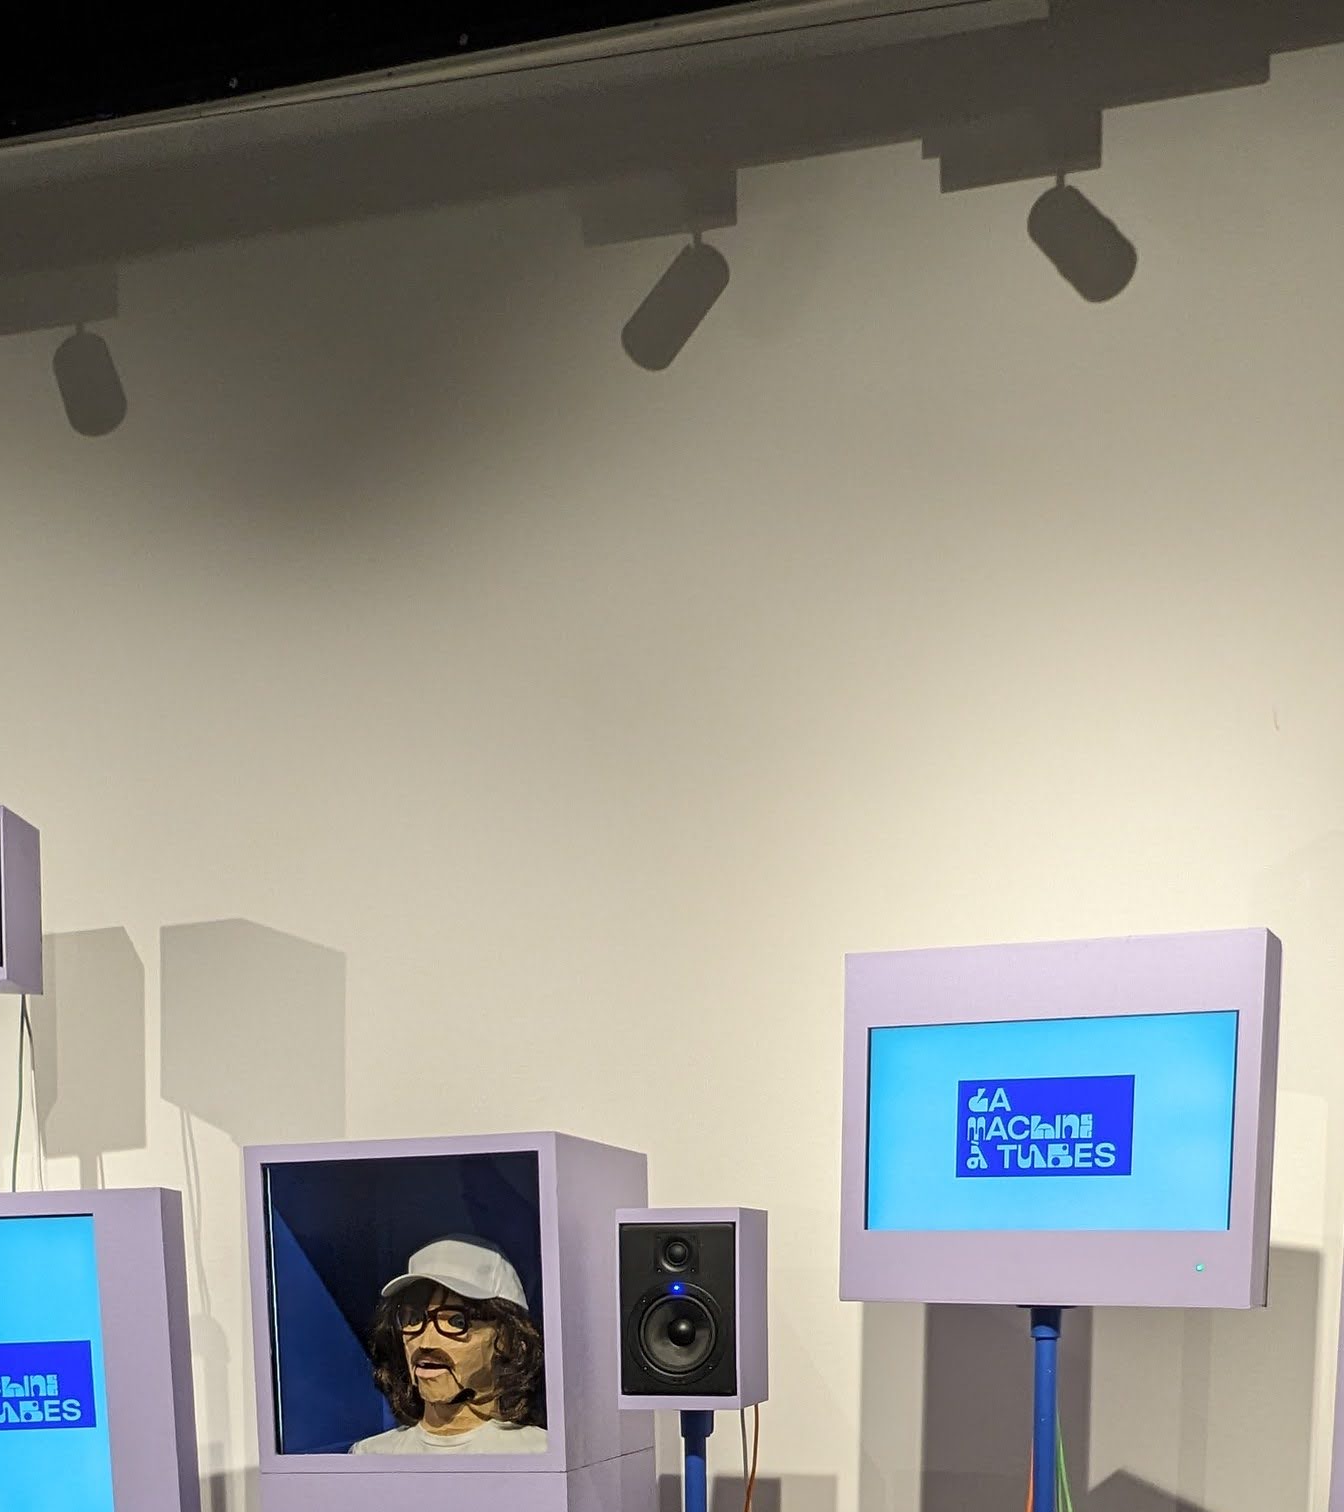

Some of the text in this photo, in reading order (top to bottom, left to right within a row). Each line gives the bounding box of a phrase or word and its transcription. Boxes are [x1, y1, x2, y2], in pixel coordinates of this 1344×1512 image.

[968, 1087, 1011, 1112] LA
[967, 1114, 1093, 1140] MACHINE
[997, 1142, 1116, 1169] TUBES
